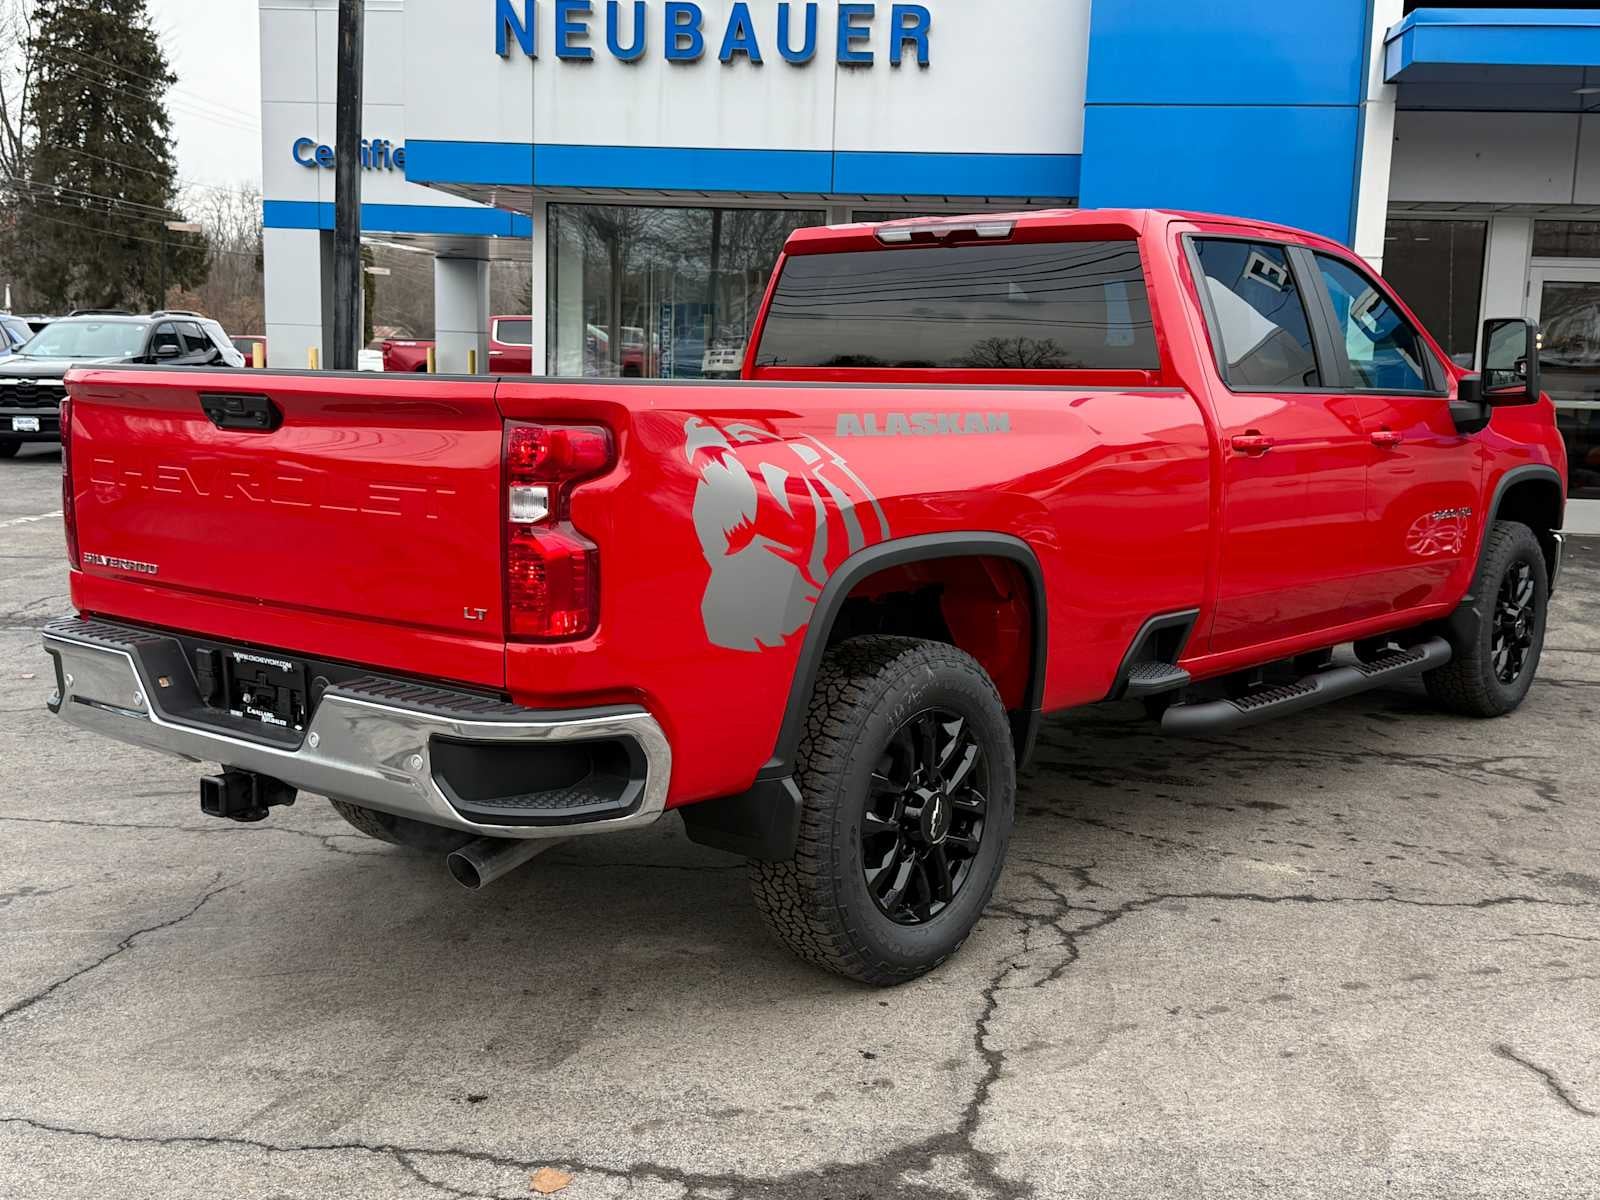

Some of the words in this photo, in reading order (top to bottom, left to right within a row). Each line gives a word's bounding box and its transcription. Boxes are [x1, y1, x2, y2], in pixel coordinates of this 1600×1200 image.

[494, 0, 932, 68] NEUBAUER
[292, 136, 406, 170] Ceifie
[463, 606, 488, 621] LT
